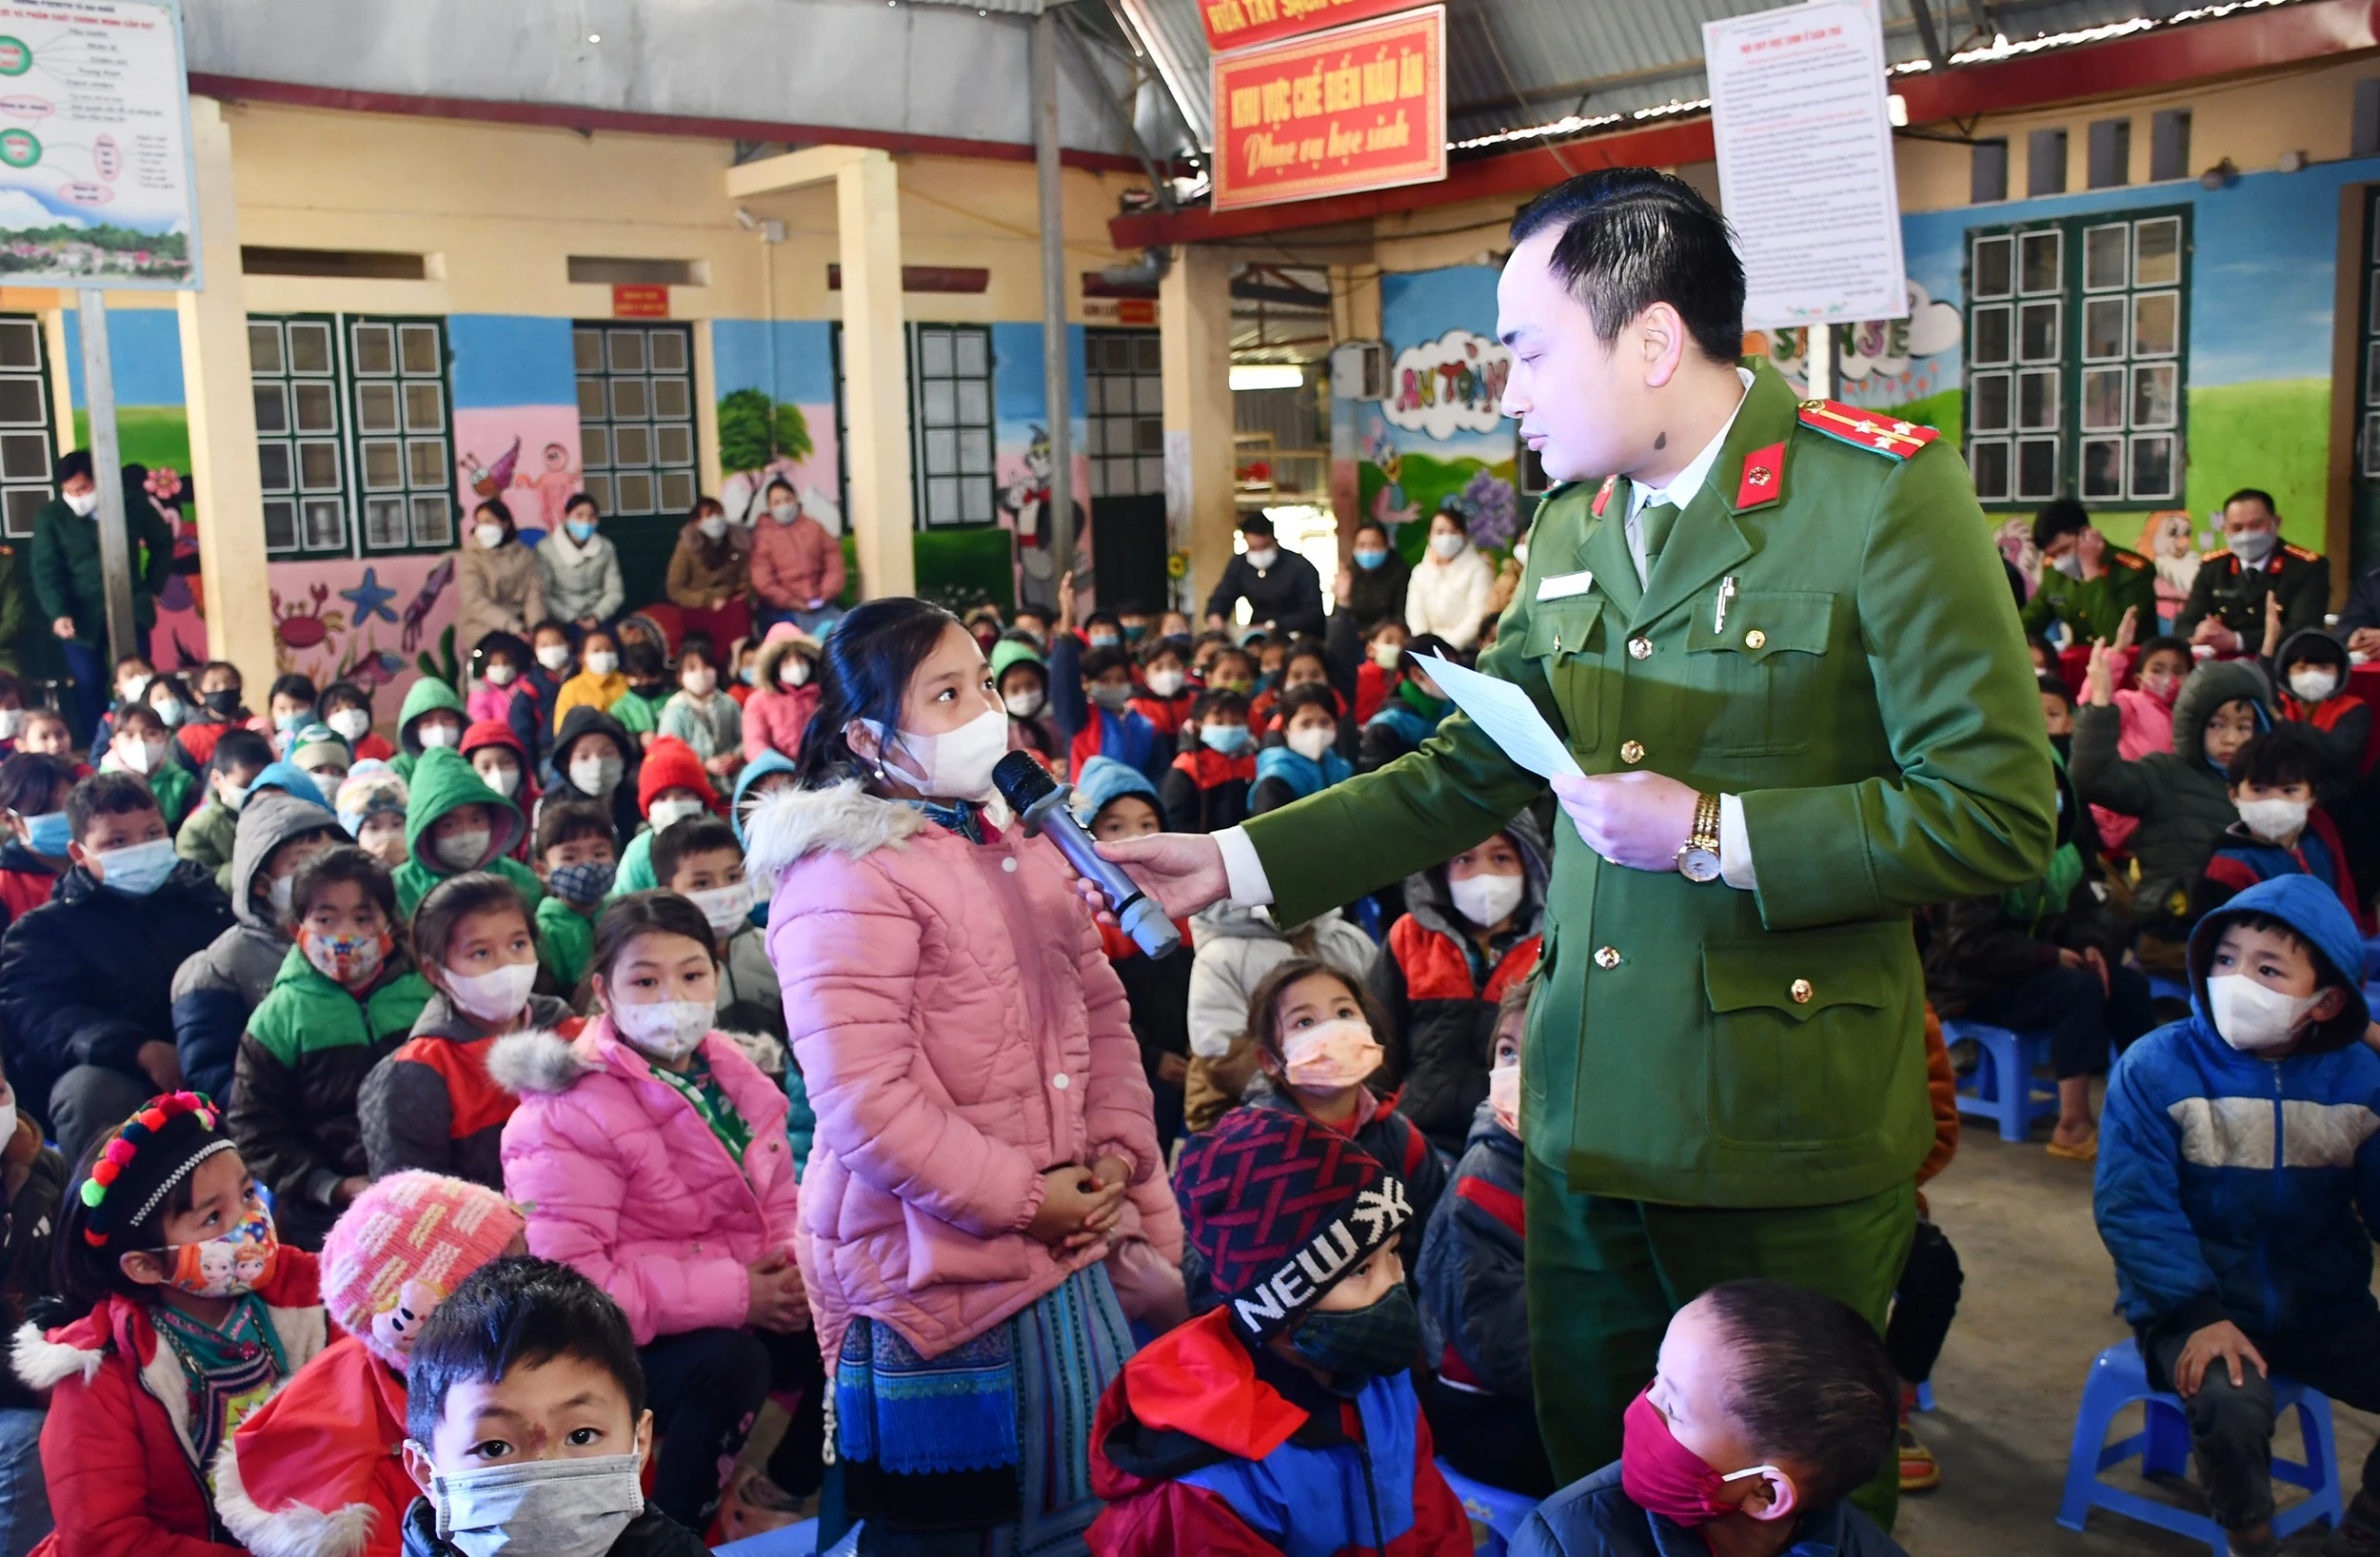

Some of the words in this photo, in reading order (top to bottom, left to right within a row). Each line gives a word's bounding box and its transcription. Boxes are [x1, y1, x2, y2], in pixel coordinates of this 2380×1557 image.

[1231, 86, 1261, 129] KHU
[1261, 77, 1292, 131] VỰC
[1292, 58, 1323, 119] CHẾ
[1324, 52, 1362, 113] BIẾN
[1362, 45, 1398, 106] NẤU
[1243, 132, 1298, 178] Phục
[1299, 138, 1325, 170] vụ
[1327, 121, 1364, 167] học
[1365, 108, 1410, 151] sinh
[1234, 1218, 1359, 1332] NEW
